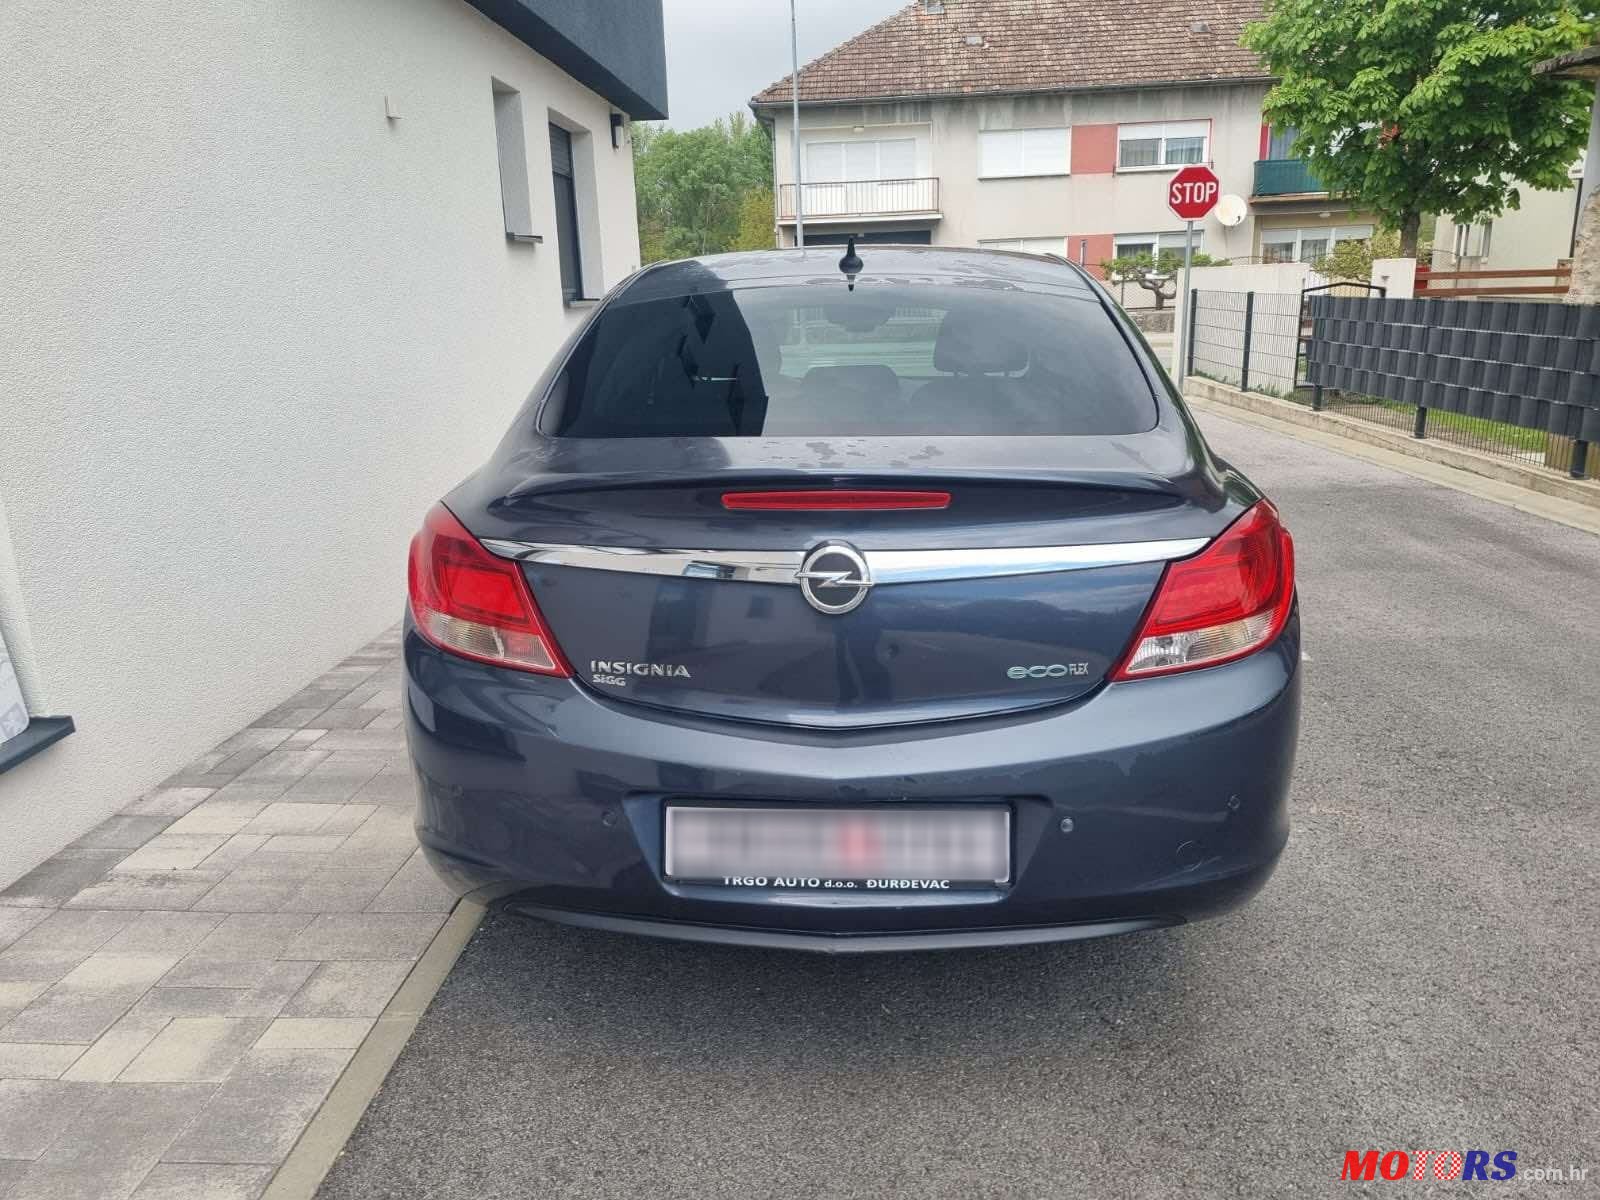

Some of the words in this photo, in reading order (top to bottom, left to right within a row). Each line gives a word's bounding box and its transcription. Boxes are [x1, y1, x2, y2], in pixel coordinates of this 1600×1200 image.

[1171, 182, 1217, 204] STOP
[590, 660, 692, 678] INSIGNIA
[722, 876, 768, 887] TRGO
[773, 877, 820, 888] AUTO
[824, 879, 858, 889] d.o.o.
[866, 879, 950, 889] ĐURĐEVAC
